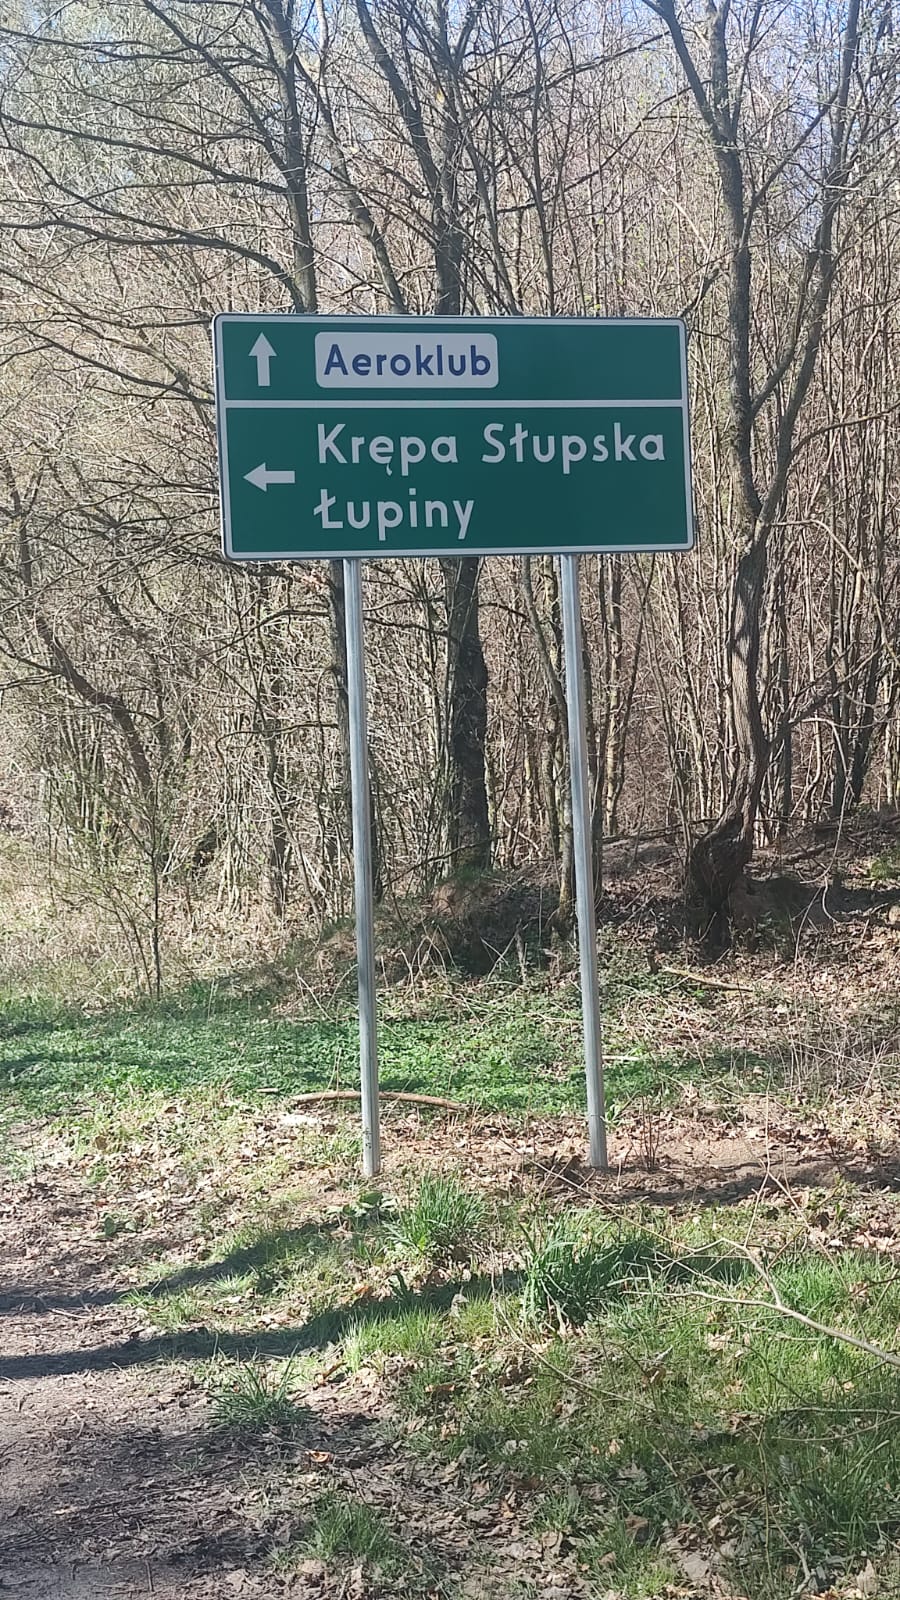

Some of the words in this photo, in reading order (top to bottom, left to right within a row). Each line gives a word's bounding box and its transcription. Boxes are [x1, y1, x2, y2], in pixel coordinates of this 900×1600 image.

[323, 344, 491, 376] Aeroklub
[316, 423, 457, 476] Krępa
[481, 422, 665, 475] Słupska
[313, 488, 475, 541] Łupiny
